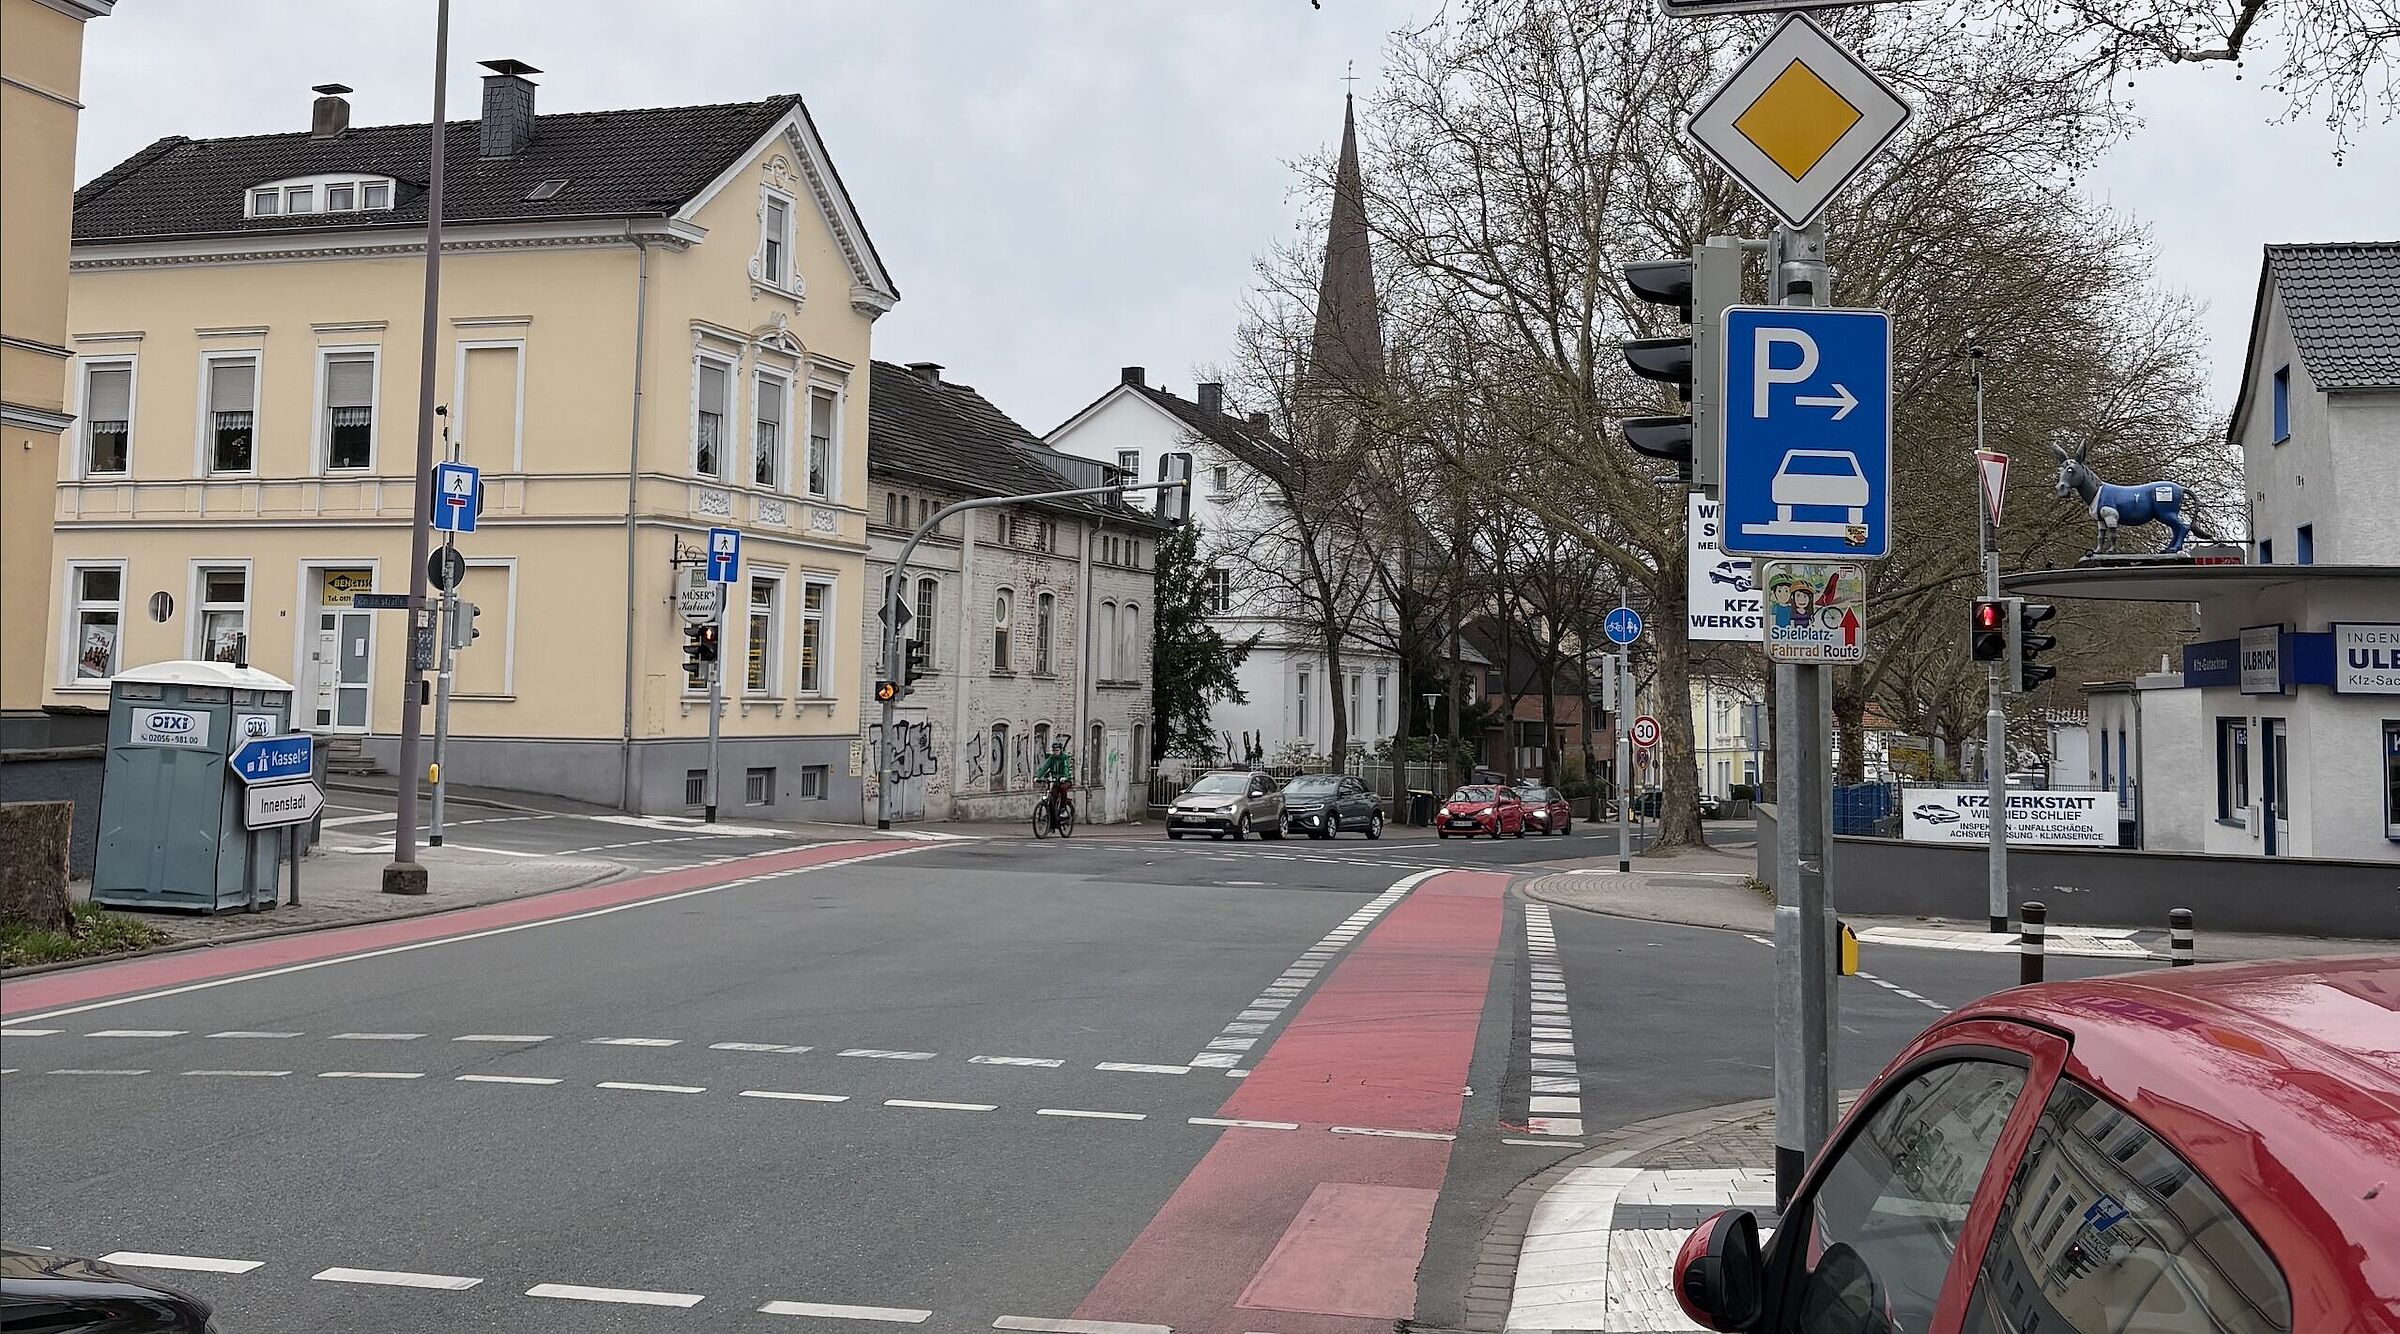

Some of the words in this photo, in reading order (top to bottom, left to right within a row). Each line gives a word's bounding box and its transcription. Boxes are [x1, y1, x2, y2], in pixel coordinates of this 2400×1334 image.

[1754, 327, 1819, 418] P
[1691, 614, 1763, 629] WERKST
[1771, 626, 1833, 642] Spielplatz-
[1771, 643, 1819, 658] Fahrrad
[1823, 644, 1859, 658] Route
[2242, 649, 2277, 672] ULBRICH
[1636, 724, 1654, 739] 30
[271, 748, 301, 767] Kassel
[261, 793, 306, 814] Innenstadt
[1971, 809, 2029, 821] WILIED
[2030, 810, 2082, 821] SCHLIEF
[1959, 822, 2012, 831] INSPEKN
[2018, 823, 2093, 833] UNFALLSCHÄDEN
[1950, 830, 2033, 840] ACHSVERSUNG
[2039, 831, 2104, 841] KLIMASERVICE
